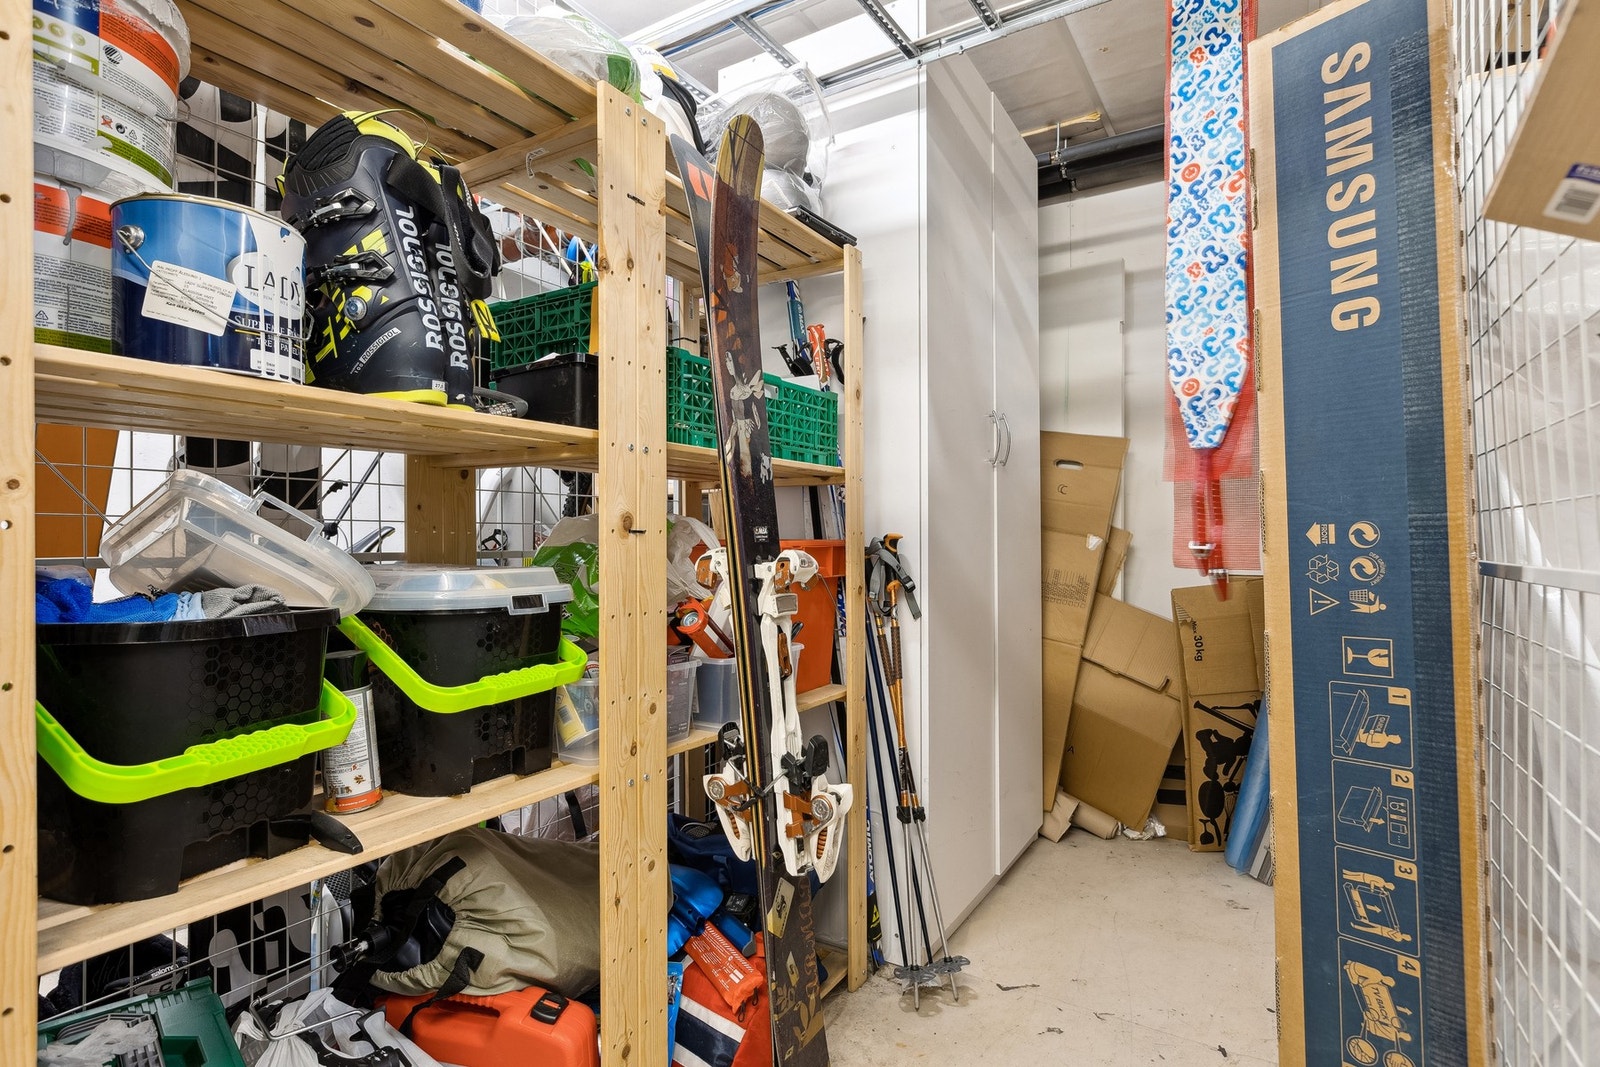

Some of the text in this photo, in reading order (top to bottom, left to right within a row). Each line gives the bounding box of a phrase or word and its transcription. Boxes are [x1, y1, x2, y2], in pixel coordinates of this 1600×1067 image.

[1321, 41, 1380, 331] SAMSUNG
[362, 329, 399, 362] ROSSIGNOL
[1395, 774, 1409, 783] 2
[1398, 865, 1412, 875] 3
[1401, 960, 1416, 971] 4
